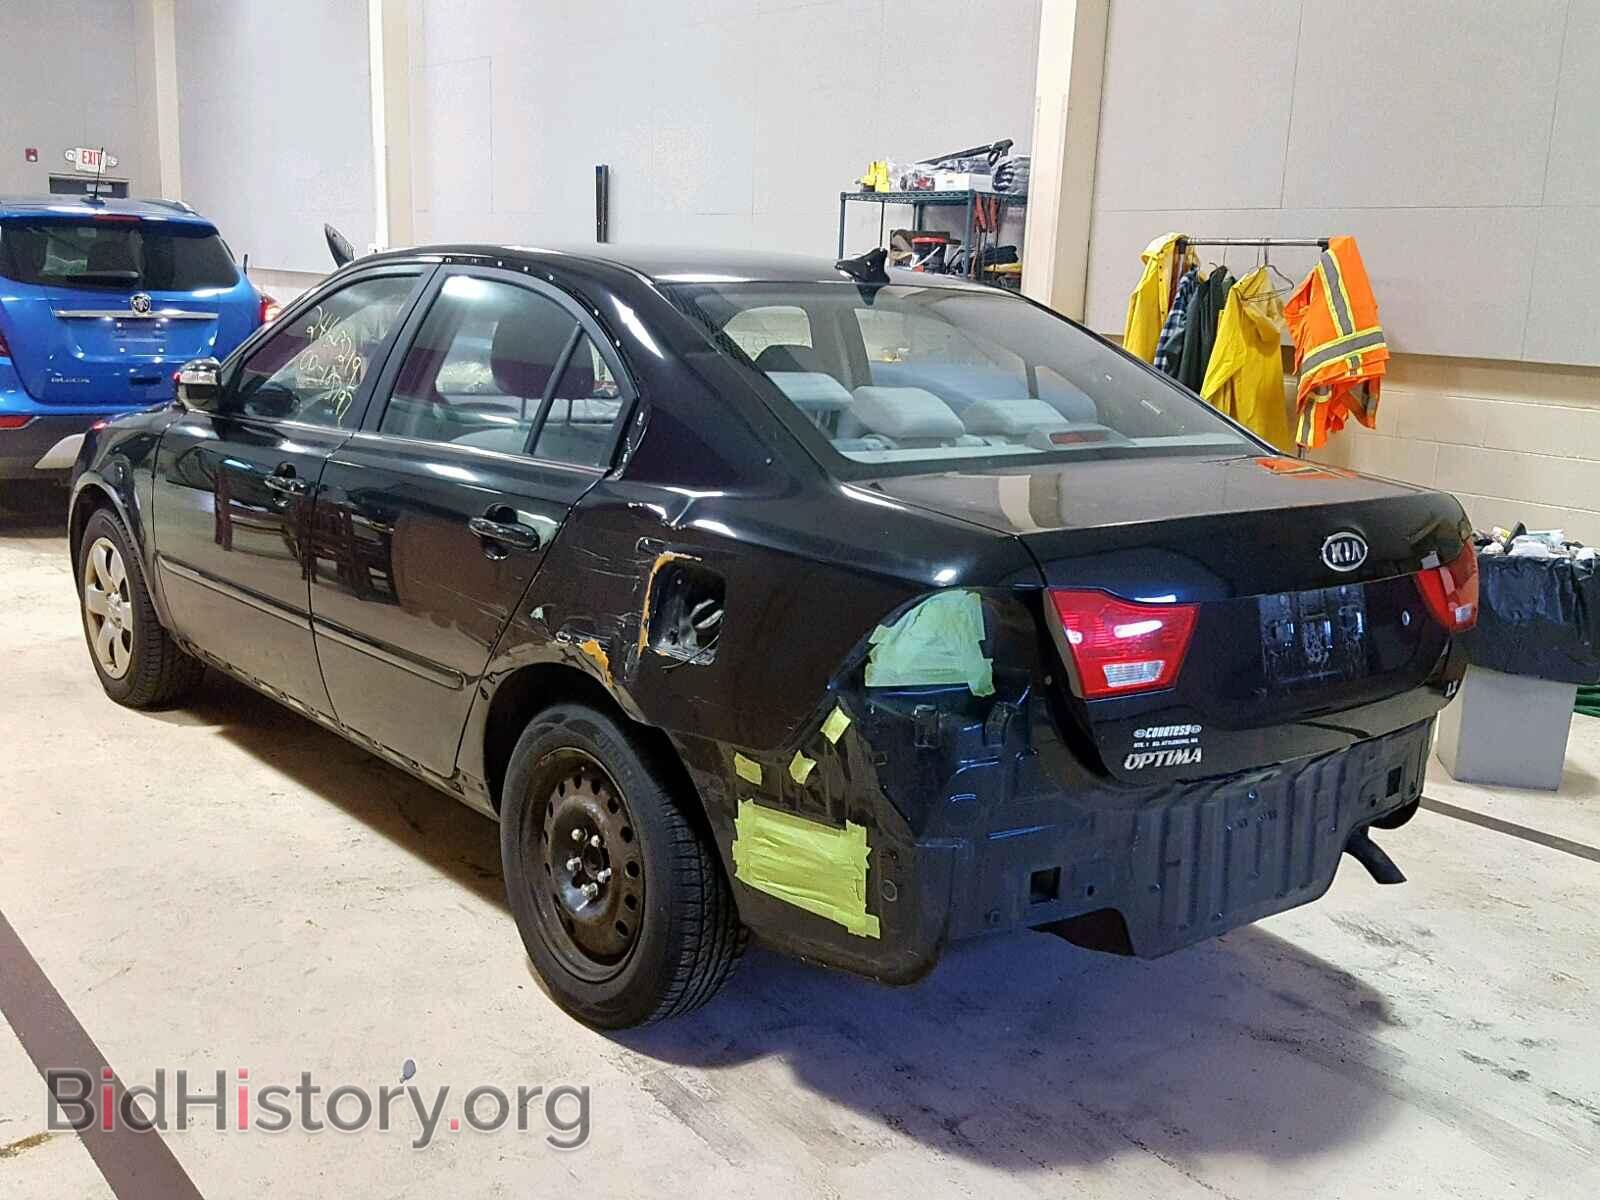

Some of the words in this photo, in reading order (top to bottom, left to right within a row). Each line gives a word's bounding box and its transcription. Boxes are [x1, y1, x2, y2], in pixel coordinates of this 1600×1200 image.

[82, 150, 102, 166] EXIT
[1330, 541, 1363, 563] KIA
[1124, 747, 1202, 770] OPTIMA
